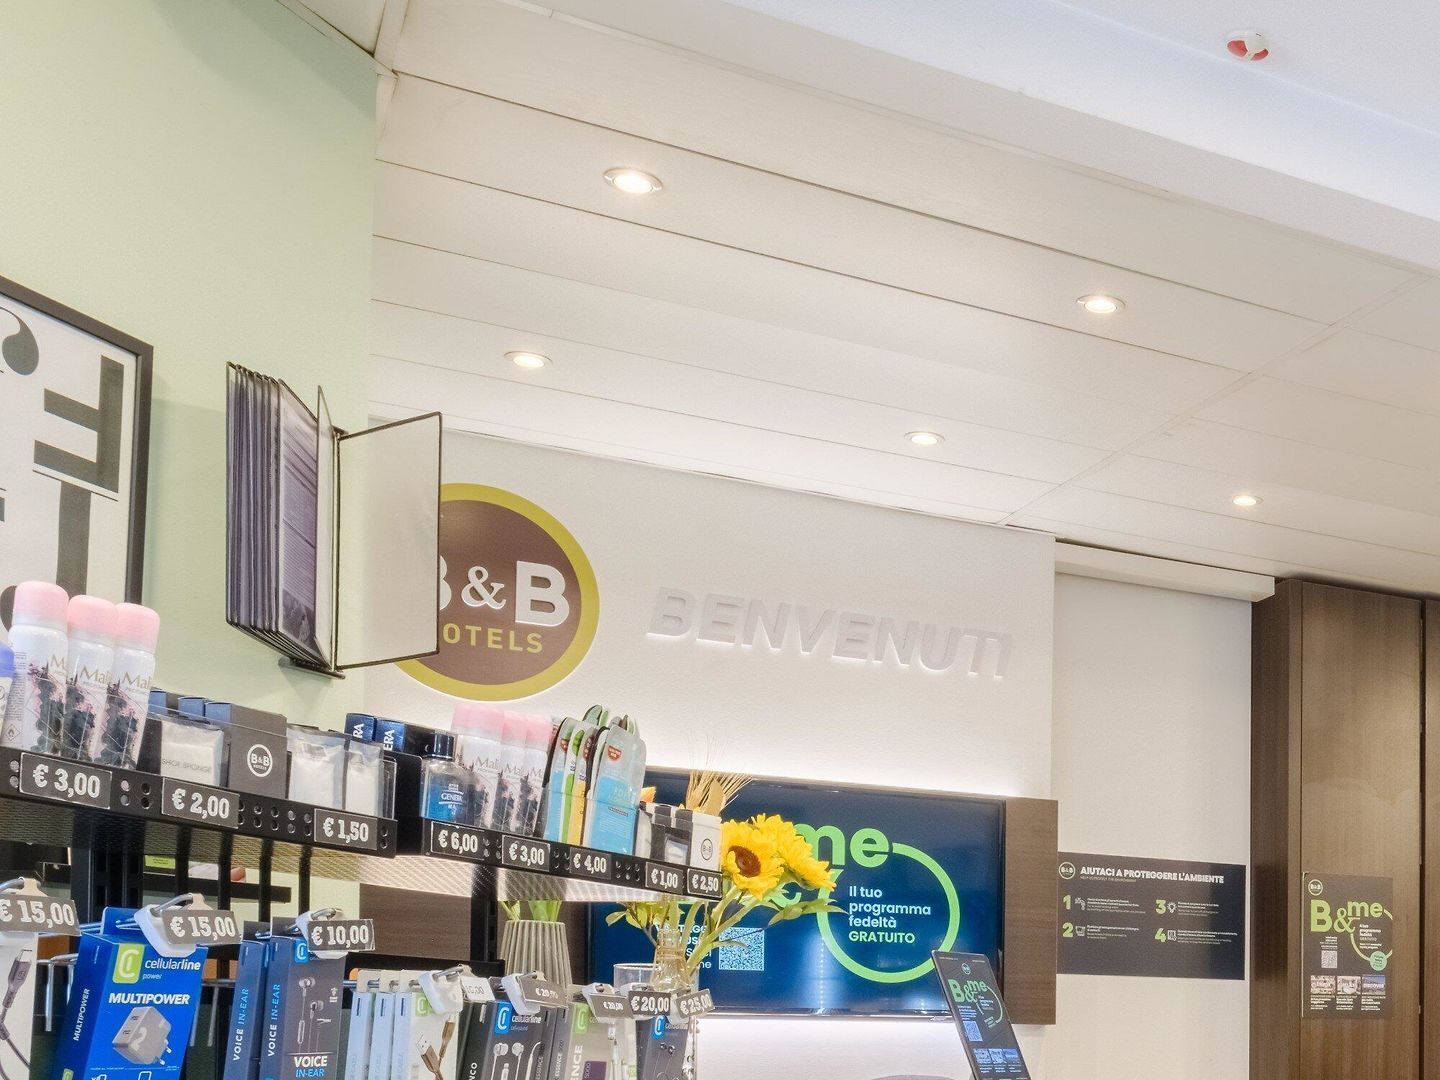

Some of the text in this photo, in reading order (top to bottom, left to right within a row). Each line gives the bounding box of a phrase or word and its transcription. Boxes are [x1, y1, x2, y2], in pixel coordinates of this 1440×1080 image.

[438, 553, 571, 627] &B
[443, 624, 544, 655] OTELS
[645, 586, 1014, 680] BENVENUTI
[250, 753, 270, 767] B&B
[54, 768, 101, 798] 3,00
[190, 792, 230, 820] 2,00
[337, 819, 369, 844] 1,50
[450, 831, 478, 855] 6,00
[519, 845, 545, 866] 3,00
[583, 855, 608, 874] 4,00
[659, 870, 679, 889] 1,00
[700, 874, 719, 894] 2,50
[1080, 866, 1116, 877] AIUTACI
[1123, 870, 1178, 881] PROTEGGERE
[1178, 872, 1225, 884] L'AMBIENTE
[848, 885, 883, 899] Il tuo
[848, 902, 932, 917] programma
[1062, 894, 1072, 910] 1
[1155, 899, 1167, 915] 3
[18, 900, 75, 930] 15,00
[848, 914, 897, 929] fedeltà
[188, 915, 237, 942] 15,00
[327, 924, 370, 949] 10,00
[848, 930, 916, 944] GRATUITO
[1062, 922, 1074, 938] 2
[1154, 927, 1167, 943] 4
[144, 958, 201, 971] cellularline
[142, 972, 162, 981] power
[108, 992, 191, 1005] MULTIPOWER
[641, 996, 670, 1015] 20,00
[687, 993, 712, 1015] 25,00
[72, 988, 91, 1042] MULTIPOWER
[232, 988, 249, 1061] VOICE IN-EAR
[267, 984, 281, 1057] VOICE IN-EAR
[293, 1055, 328, 1068] VOICE
[295, 1068, 325, 1078] IN-EAR
